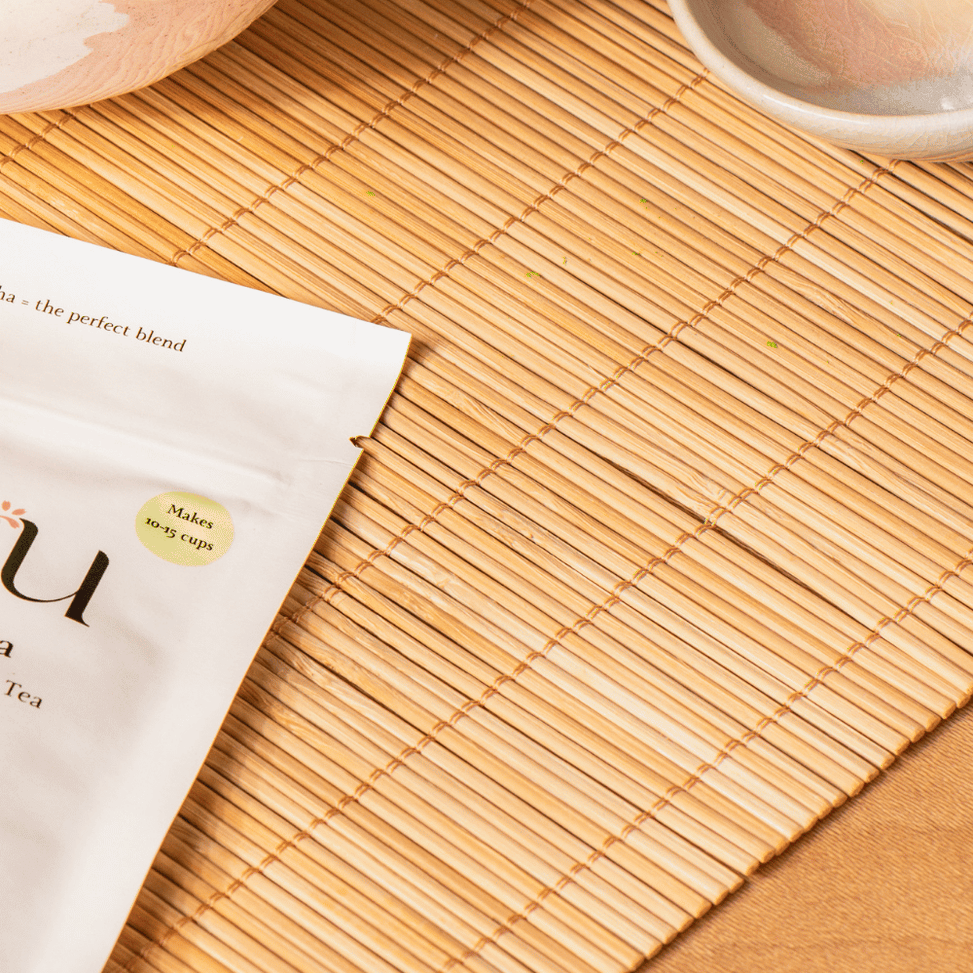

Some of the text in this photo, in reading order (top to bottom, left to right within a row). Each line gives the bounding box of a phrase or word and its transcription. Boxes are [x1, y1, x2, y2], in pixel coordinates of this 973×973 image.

[20, 299, 30, 307] =
[35, 299, 65, 318] the
[66, 311, 131, 338] perfect
[135, 326, 187, 353] blend
[166, 503, 214, 530] Makes
[144, 516, 215, 552] 10-15 cups
[4, 678, 44, 710] Tea
